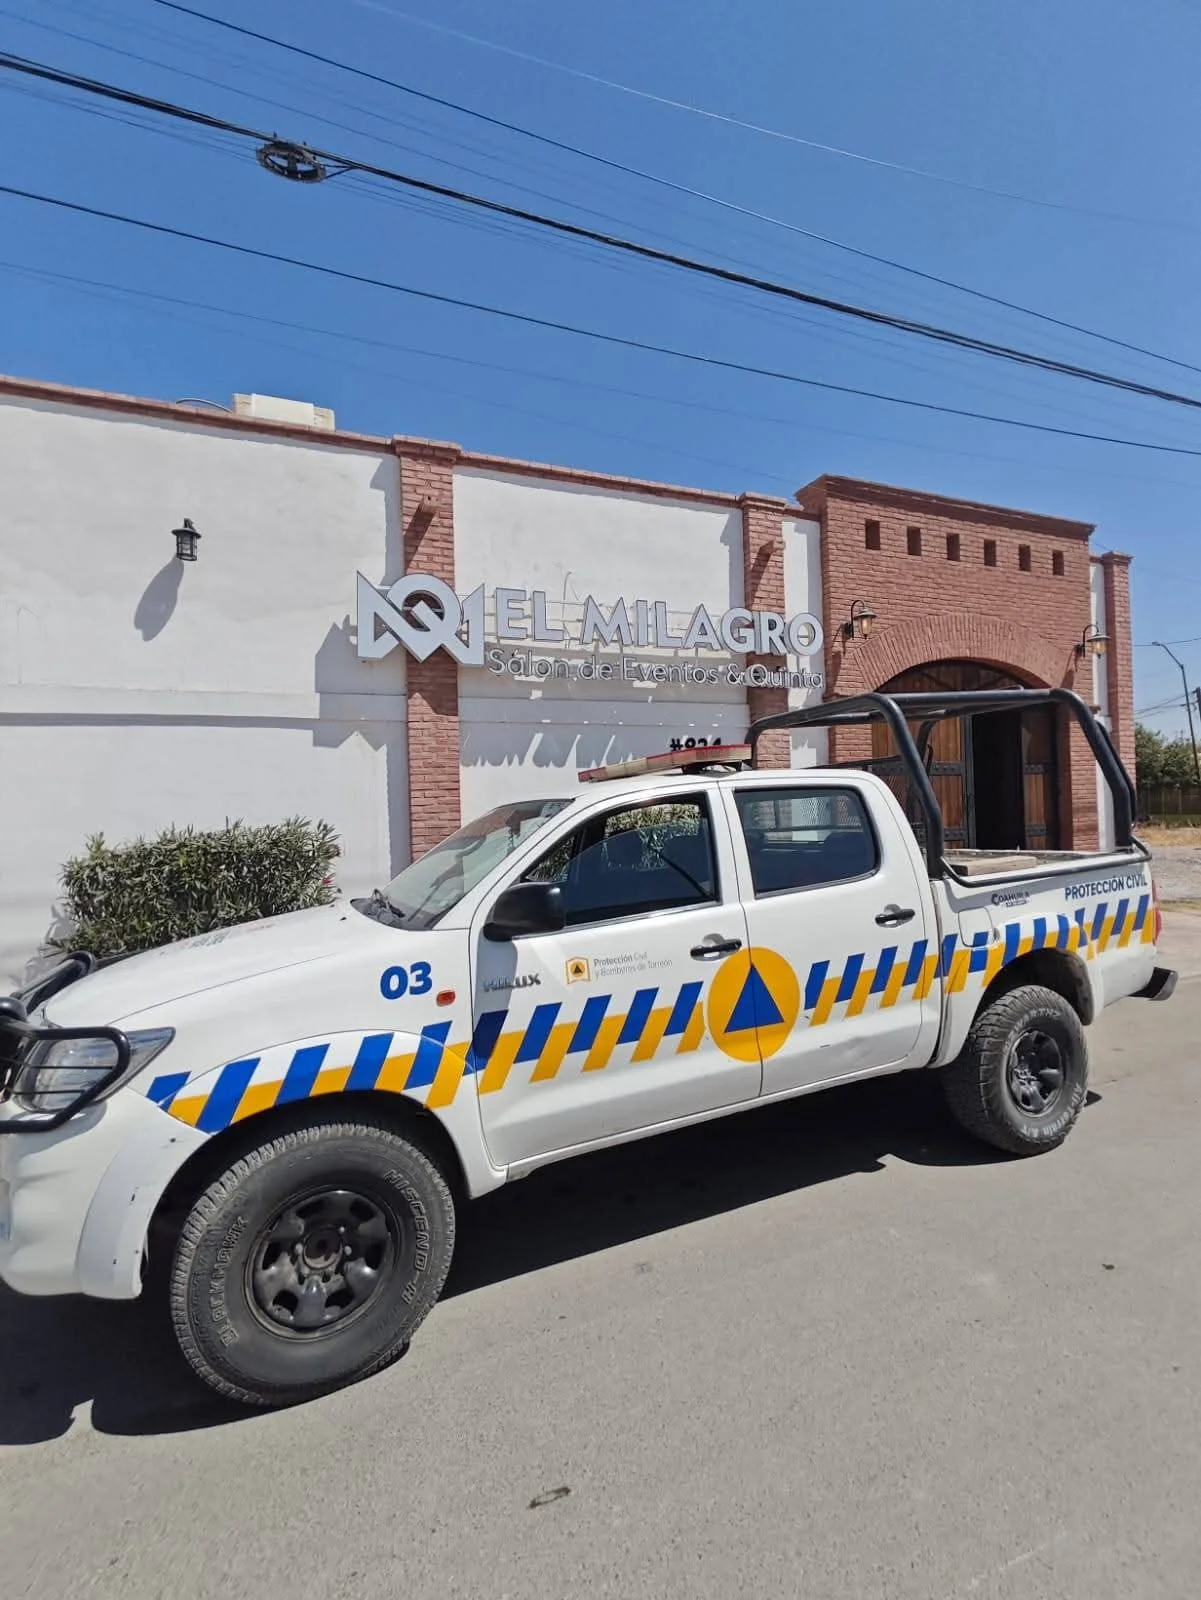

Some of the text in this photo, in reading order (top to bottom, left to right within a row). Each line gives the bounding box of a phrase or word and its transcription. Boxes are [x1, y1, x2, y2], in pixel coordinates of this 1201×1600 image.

[495, 587, 565, 642] EL
[580, 594, 824, 656] MILAGRO
[578, 654, 613, 681] de
[622, 656, 719, 685] Eventos
[726, 662, 742, 686] &
[750, 663, 824, 689] Quinta
[1065, 873, 1147, 901] PROTECCIÓN CIVIL
[593, 954, 633, 967] Protección
[380, 961, 432, 1000] 03
